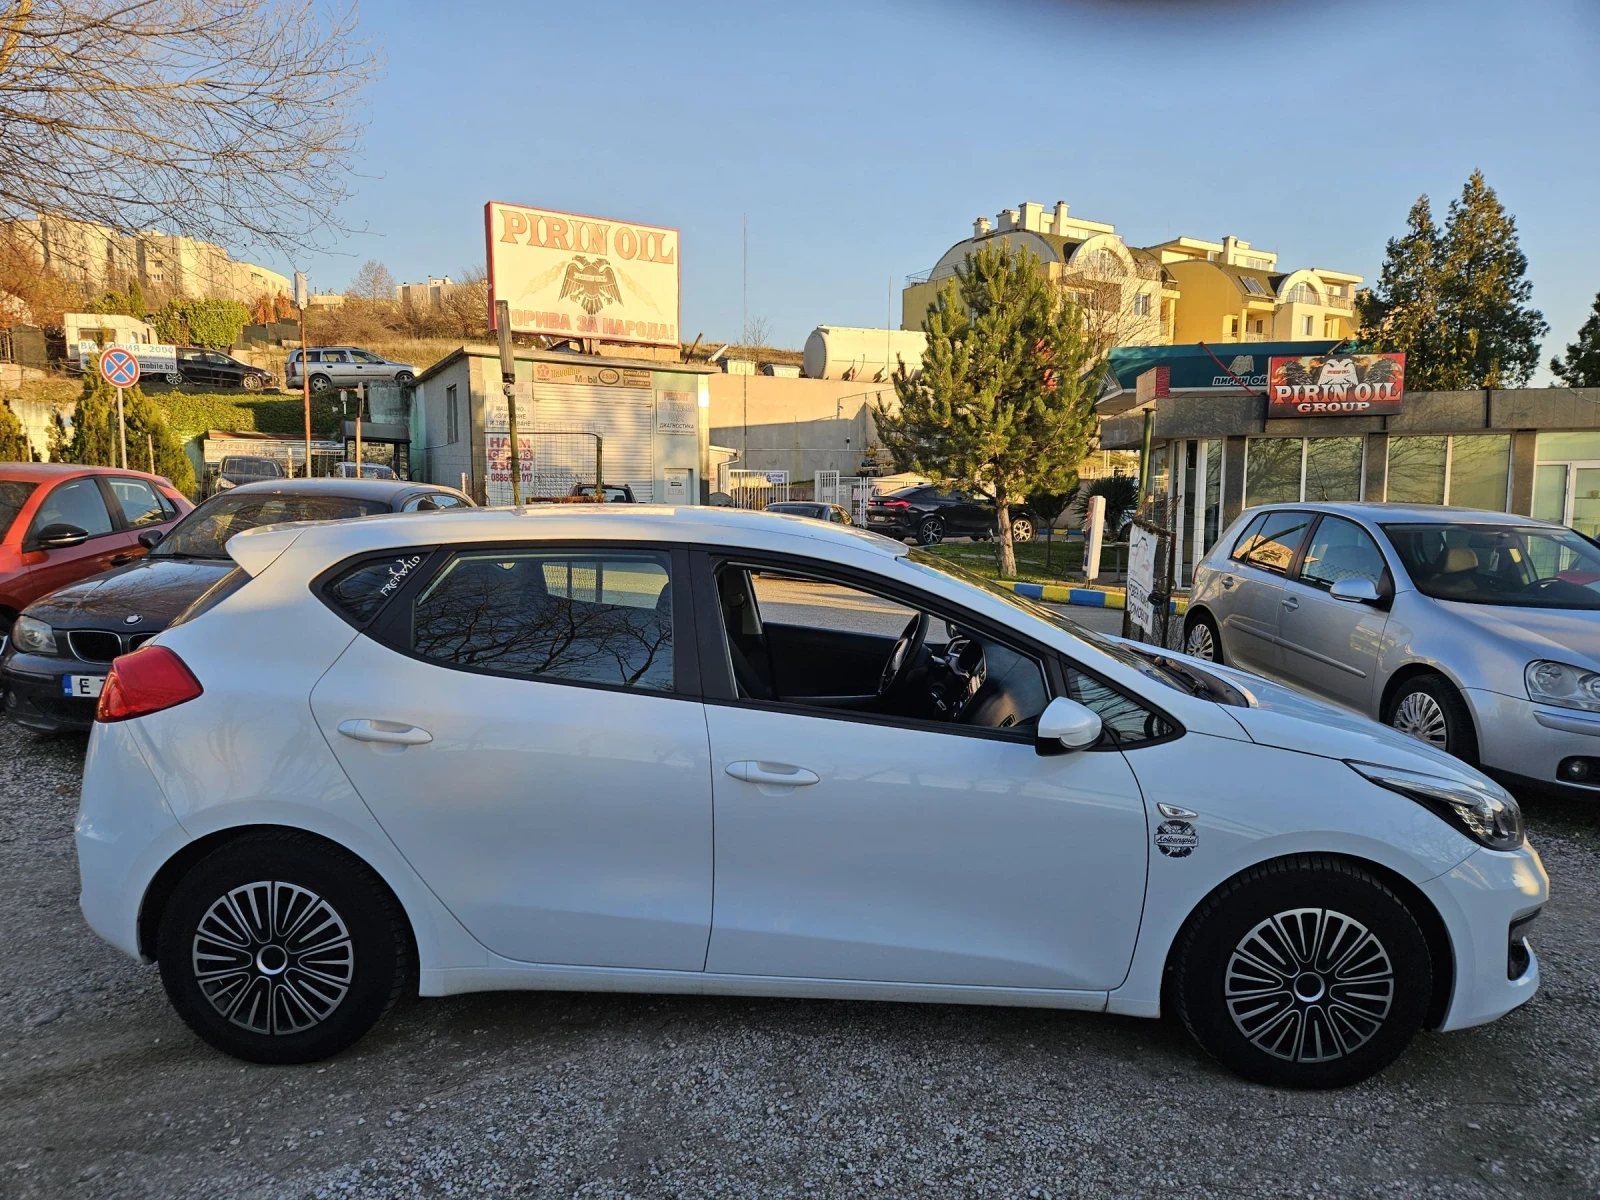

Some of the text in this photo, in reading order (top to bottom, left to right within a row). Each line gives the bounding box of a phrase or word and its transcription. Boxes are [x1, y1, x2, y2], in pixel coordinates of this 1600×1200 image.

[499, 209, 674, 264] PIRIN OIL
[508, 308, 675, 340] ОРИВА ЗА НАРОДА!
[80, 341, 140, 352] ВИТОРИЯ
[149, 346, 174, 354] 2000
[574, 375, 598, 384] Mobil
[1212, 373, 1268, 386] ПИРИН ОЙ
[1273, 382, 1403, 404] PIRIN OIL
[1297, 402, 1371, 413] GROUP
[490, 437, 531, 448] НАМ
[490, 450, 531, 459] СЕРИЗ
